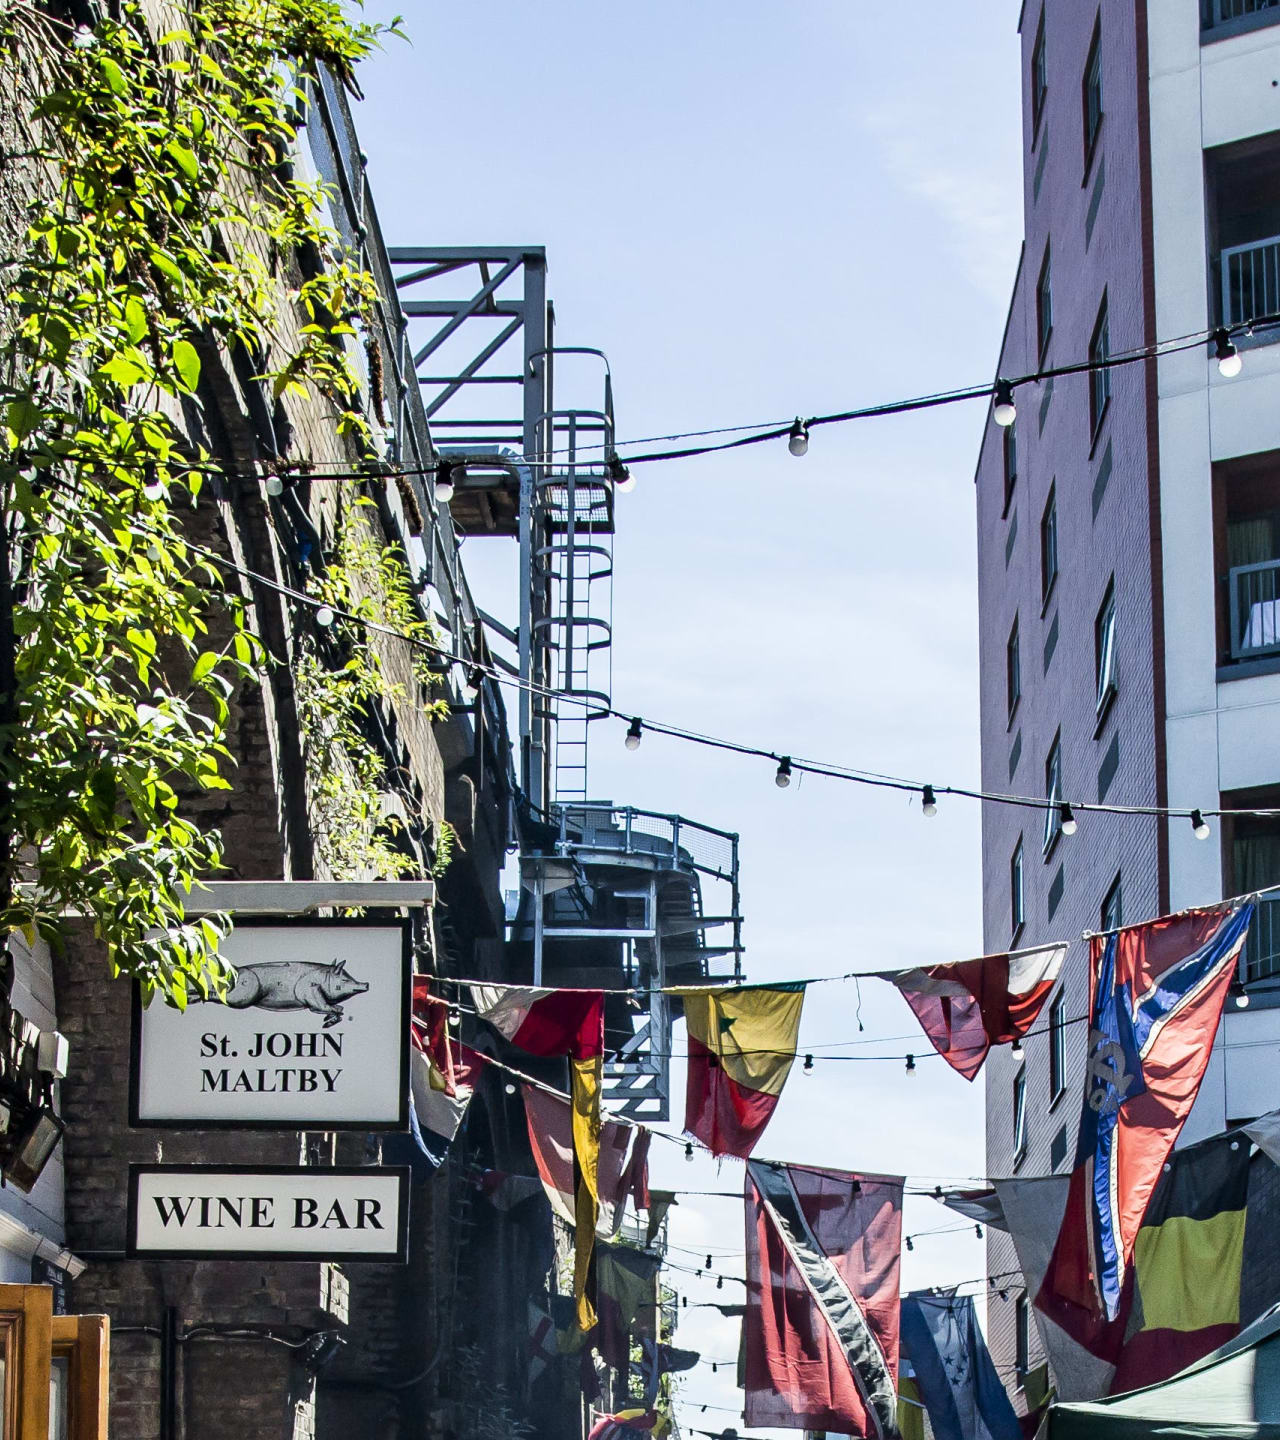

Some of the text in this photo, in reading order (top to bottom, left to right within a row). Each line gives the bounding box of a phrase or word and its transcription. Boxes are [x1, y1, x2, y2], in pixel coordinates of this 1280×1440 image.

[199, 1032, 344, 1058] St. JOHN
[200, 1068, 343, 1093] MALTBY
[153, 1196, 385, 1230] WINE BAR
